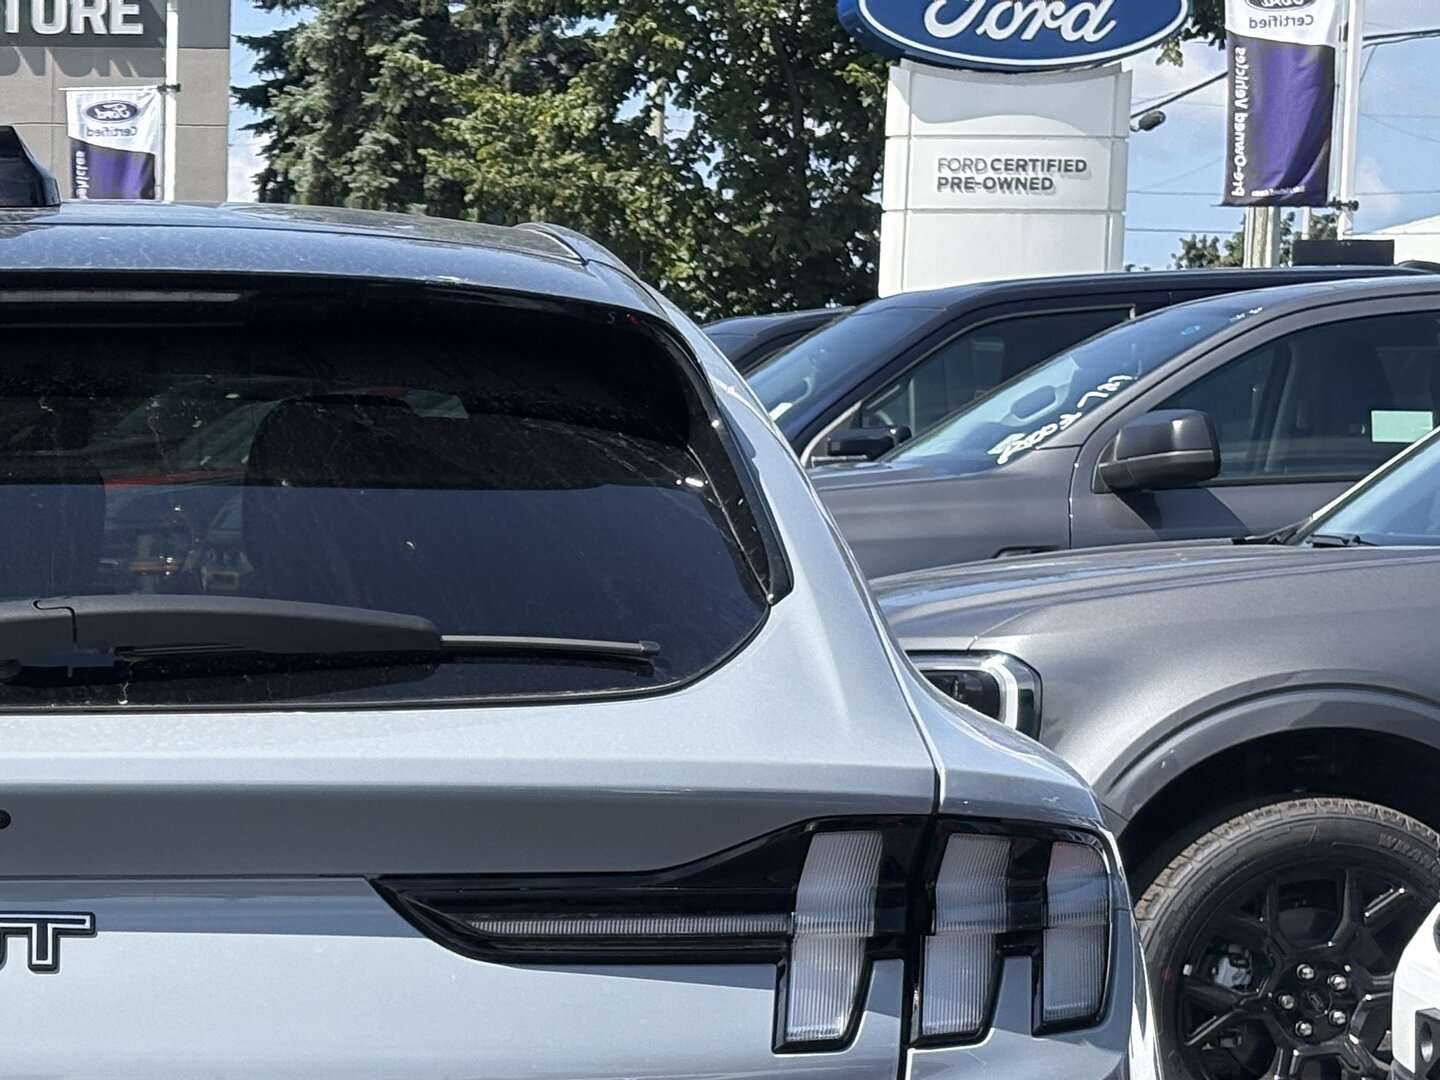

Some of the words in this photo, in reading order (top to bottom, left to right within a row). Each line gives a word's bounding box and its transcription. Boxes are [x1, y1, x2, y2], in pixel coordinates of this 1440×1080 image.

[937, 157, 988, 174] FORD
[990, 157, 1088, 174] CERTIFIED
[936, 176, 1054, 192] PRE-OWNED
